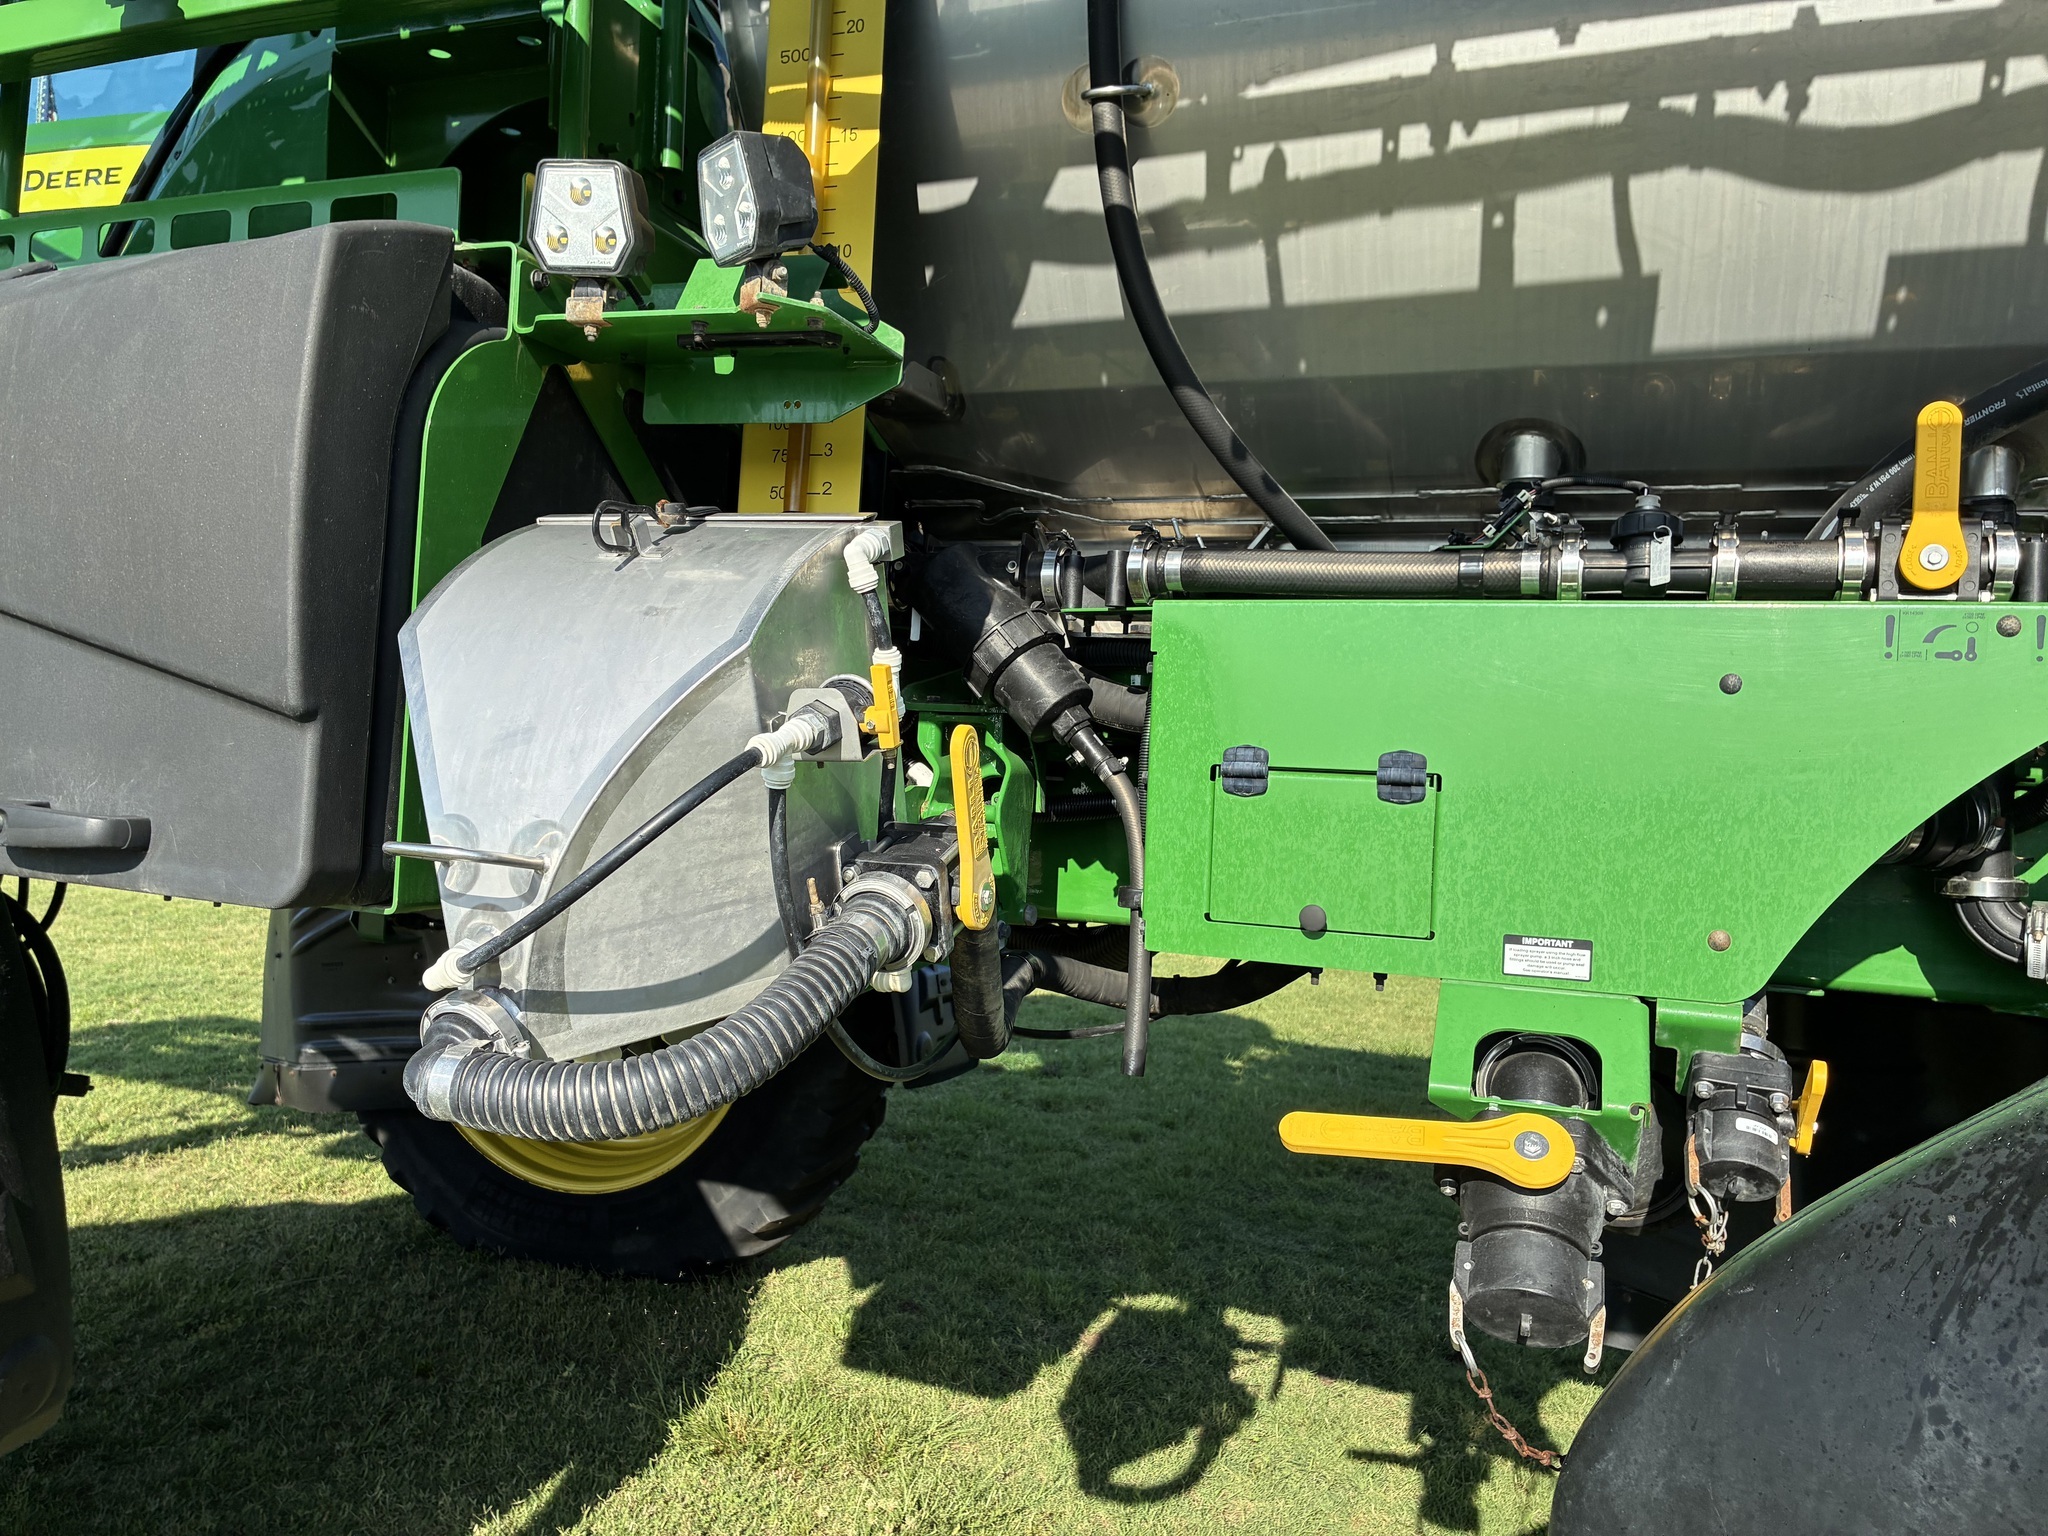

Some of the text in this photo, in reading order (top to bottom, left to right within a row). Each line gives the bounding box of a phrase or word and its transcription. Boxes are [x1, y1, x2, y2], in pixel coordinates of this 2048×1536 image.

[846, 18, 864, 34] 20
[780, 48, 810, 64] 500
[780, 130, 804, 142] 00
[841, 127, 858, 142] 15
[24, 167, 122, 192] DEERE
[1964, 398, 2006, 426] FRONTIER
[772, 449, 788, 463] 75
[824, 442, 833, 457] 3
[1925, 406, 1954, 498] BANJO
[1888, 463, 1901, 475] 200
[1878, 472, 1890, 484] PSI
[770, 486, 785, 499] 50
[822, 482, 832, 495] 2
[1522, 937, 1574, 948] IMPORTANT
